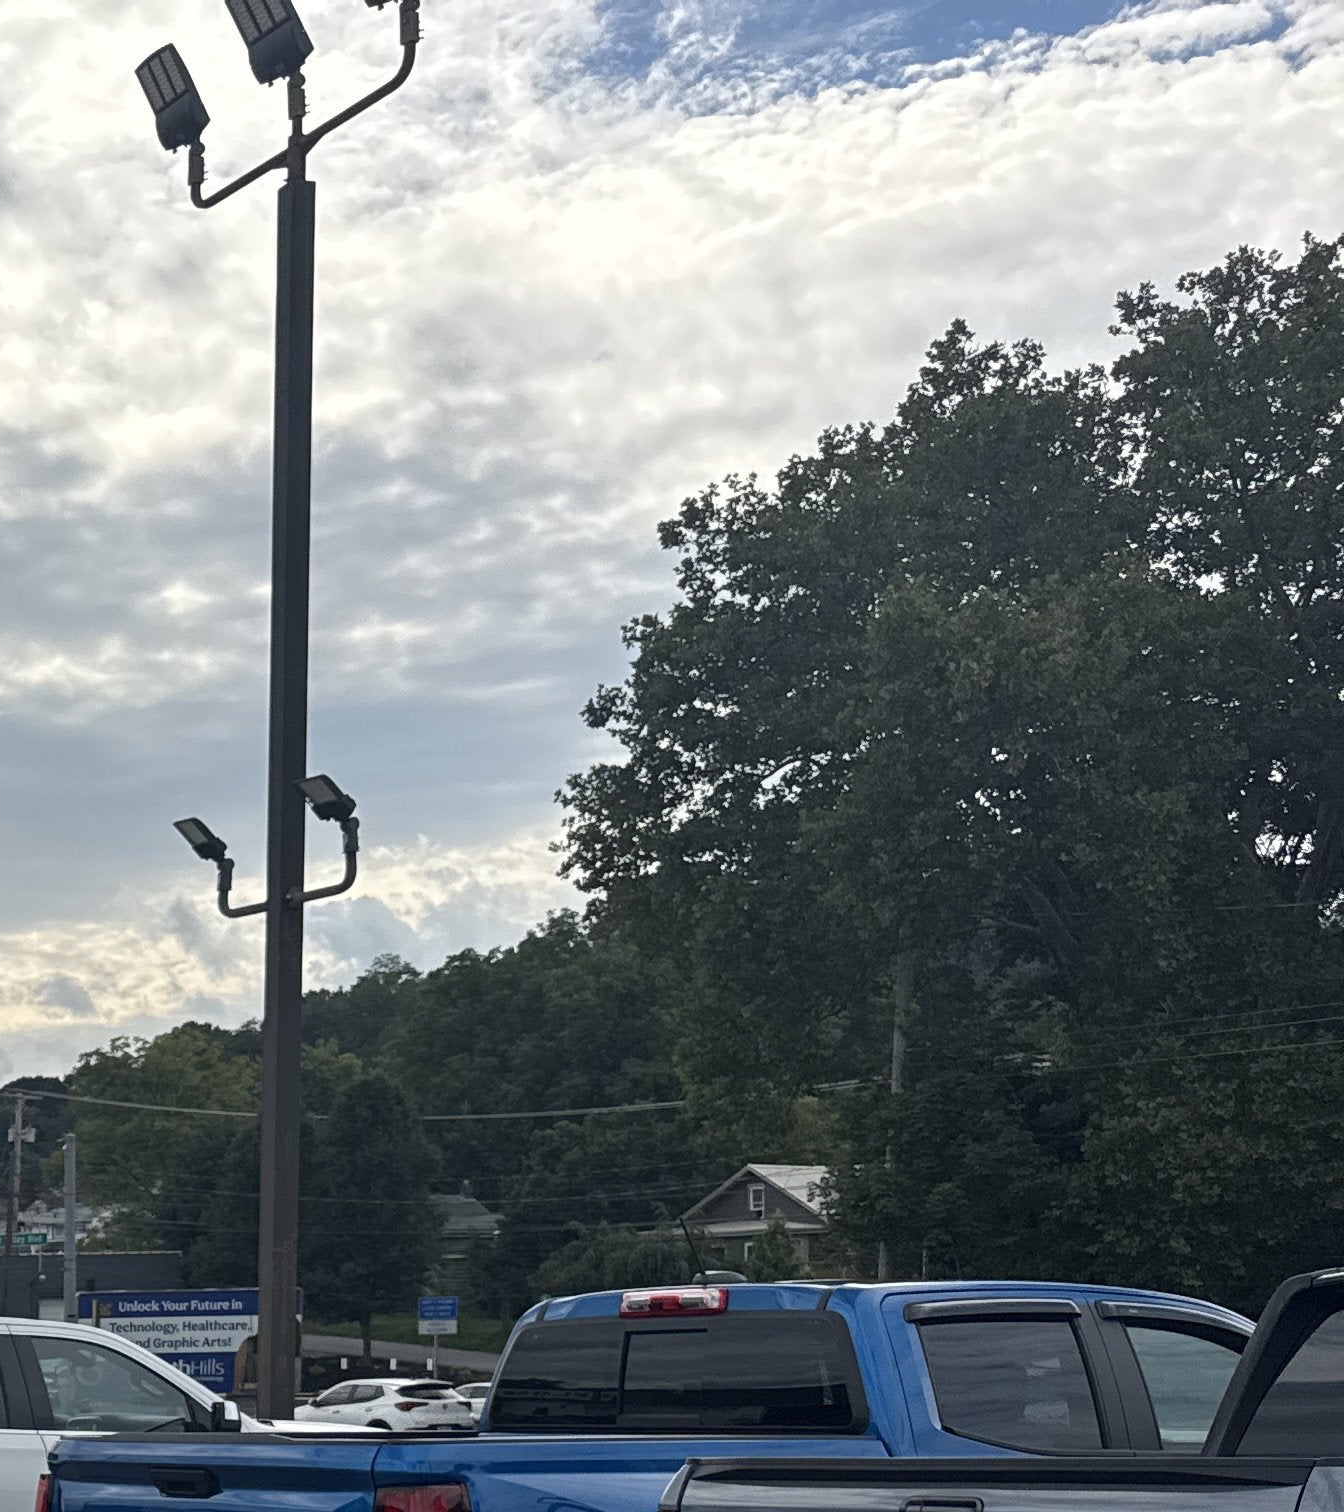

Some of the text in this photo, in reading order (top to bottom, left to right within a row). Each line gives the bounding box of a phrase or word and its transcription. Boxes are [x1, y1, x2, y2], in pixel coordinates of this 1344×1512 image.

[118, 1300, 160, 1313] Unlock
[162, 1300, 189, 1312] Your
[190, 1299, 230, 1311] Future
[109, 1319, 251, 1335] Technology, Healthcare,
[134, 1336, 232, 1351] nd Graphic Arts!
